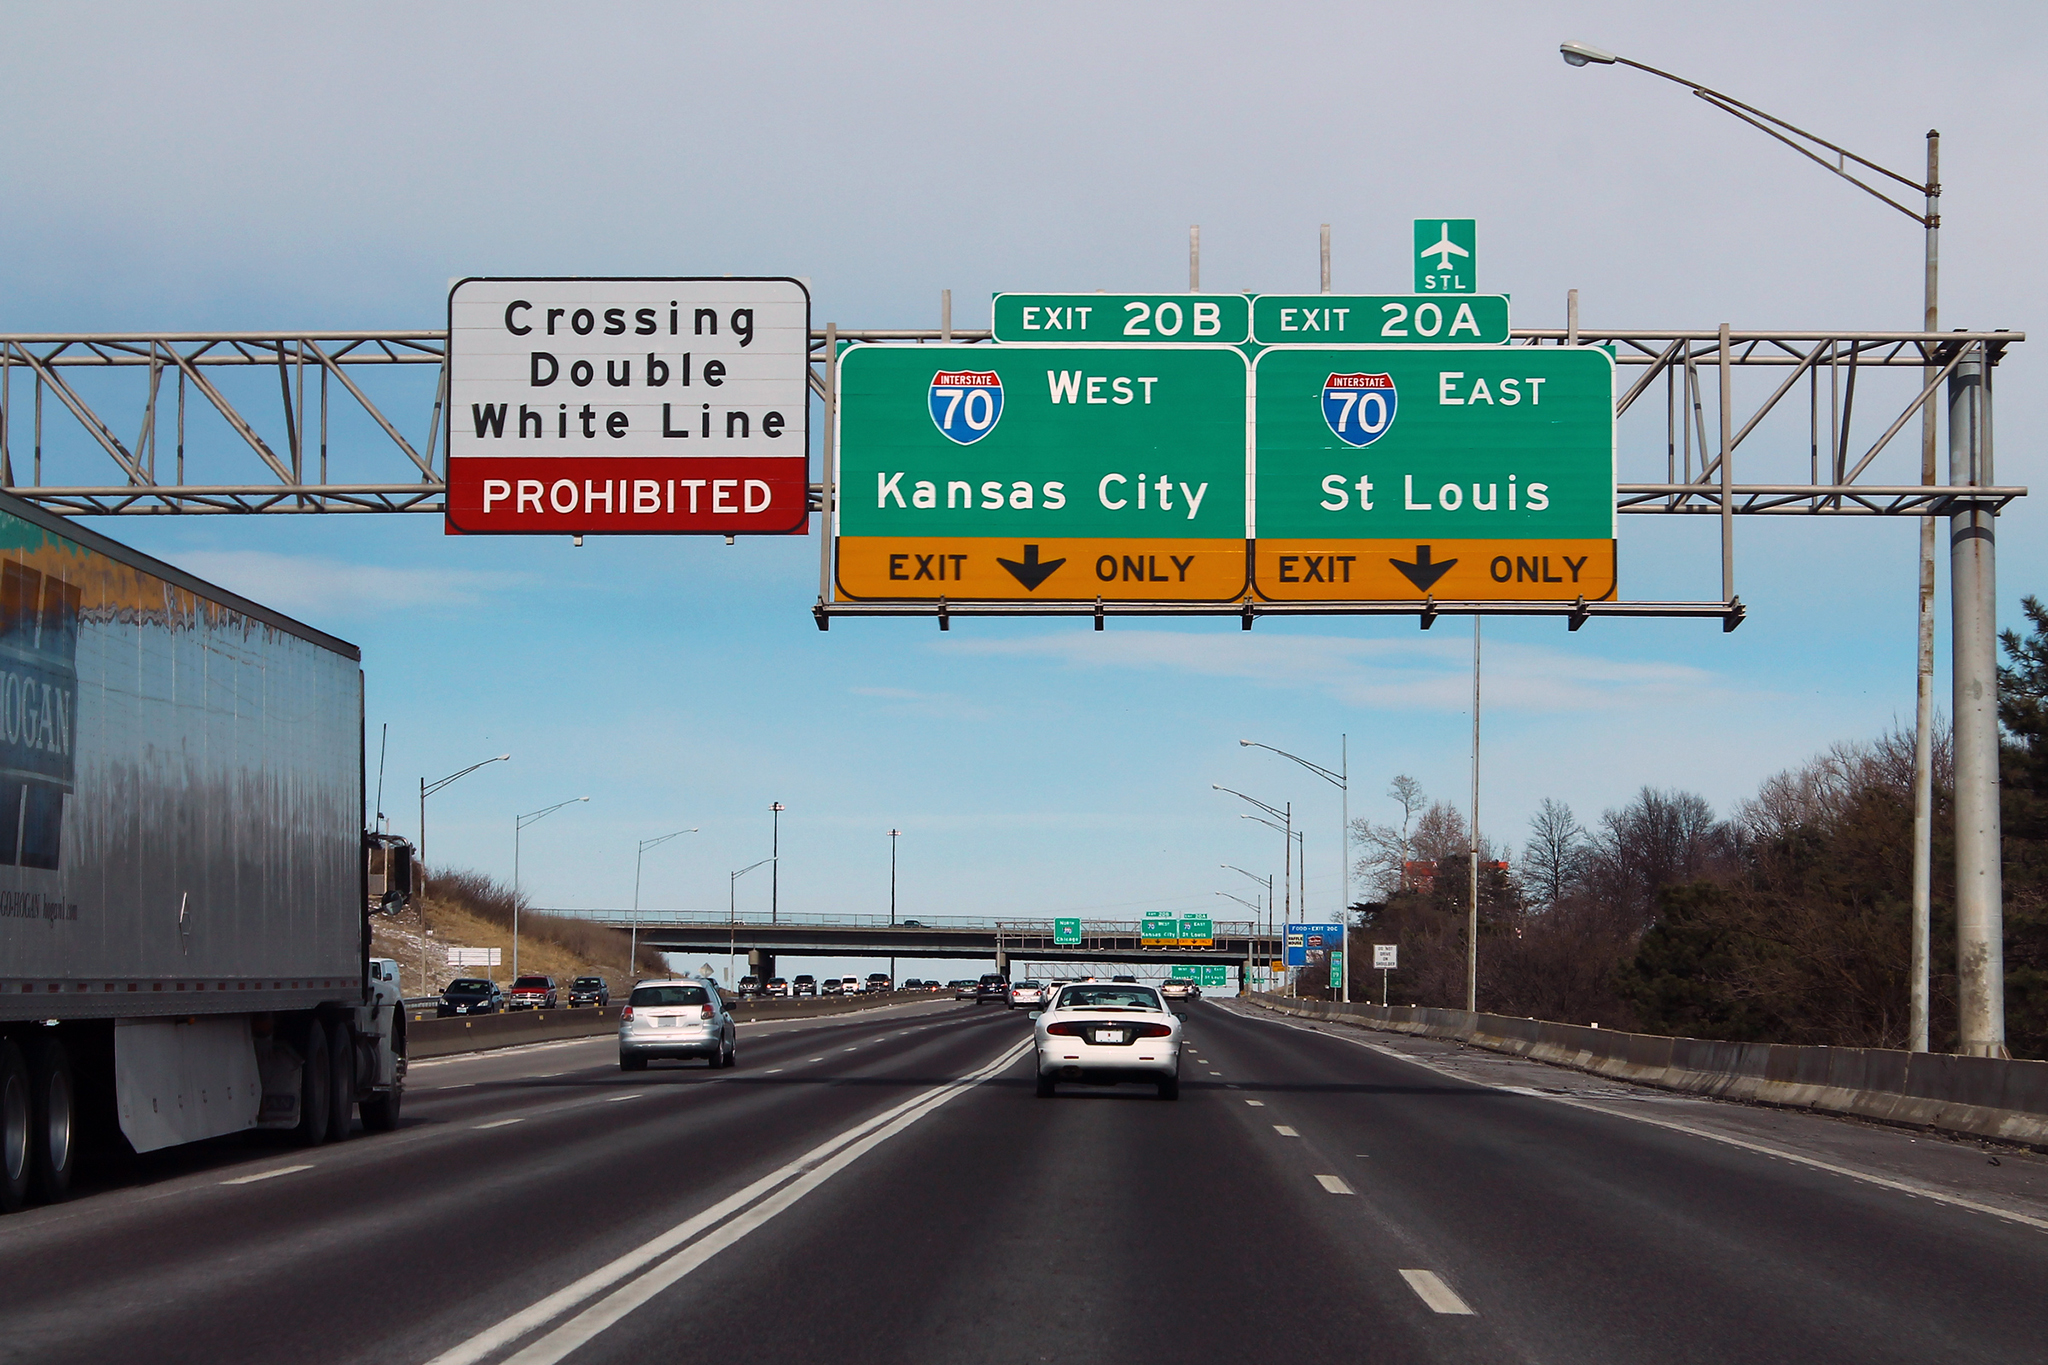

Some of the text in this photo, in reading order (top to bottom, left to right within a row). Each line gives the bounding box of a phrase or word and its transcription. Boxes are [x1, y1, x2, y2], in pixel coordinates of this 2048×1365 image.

[1424, 275, 1466, 290] STL
[504, 300, 754, 348] Crossing
[1022, 301, 1222, 336] EXIT 20B
[1280, 302, 1482, 337] EXIT 20A
[530, 351, 727, 387] Double
[940, 375, 992, 386] INTERSTATE
[1333, 377, 1386, 388] INTERSTATE
[1047, 370, 1159, 405] WEST
[1439, 371, 1547, 406] EAST
[471, 403, 786, 439] White Line
[935, 389, 994, 431] 70
[1328, 392, 1388, 433] 70
[482, 479, 772, 514] PROHIBITED
[877, 472, 1209, 520] Kansas City
[1320, 474, 1550, 511] St Louis
[889, 554, 1195, 582] EXIT ONLY
[1278, 556, 1588, 583] EXIT ONLY
